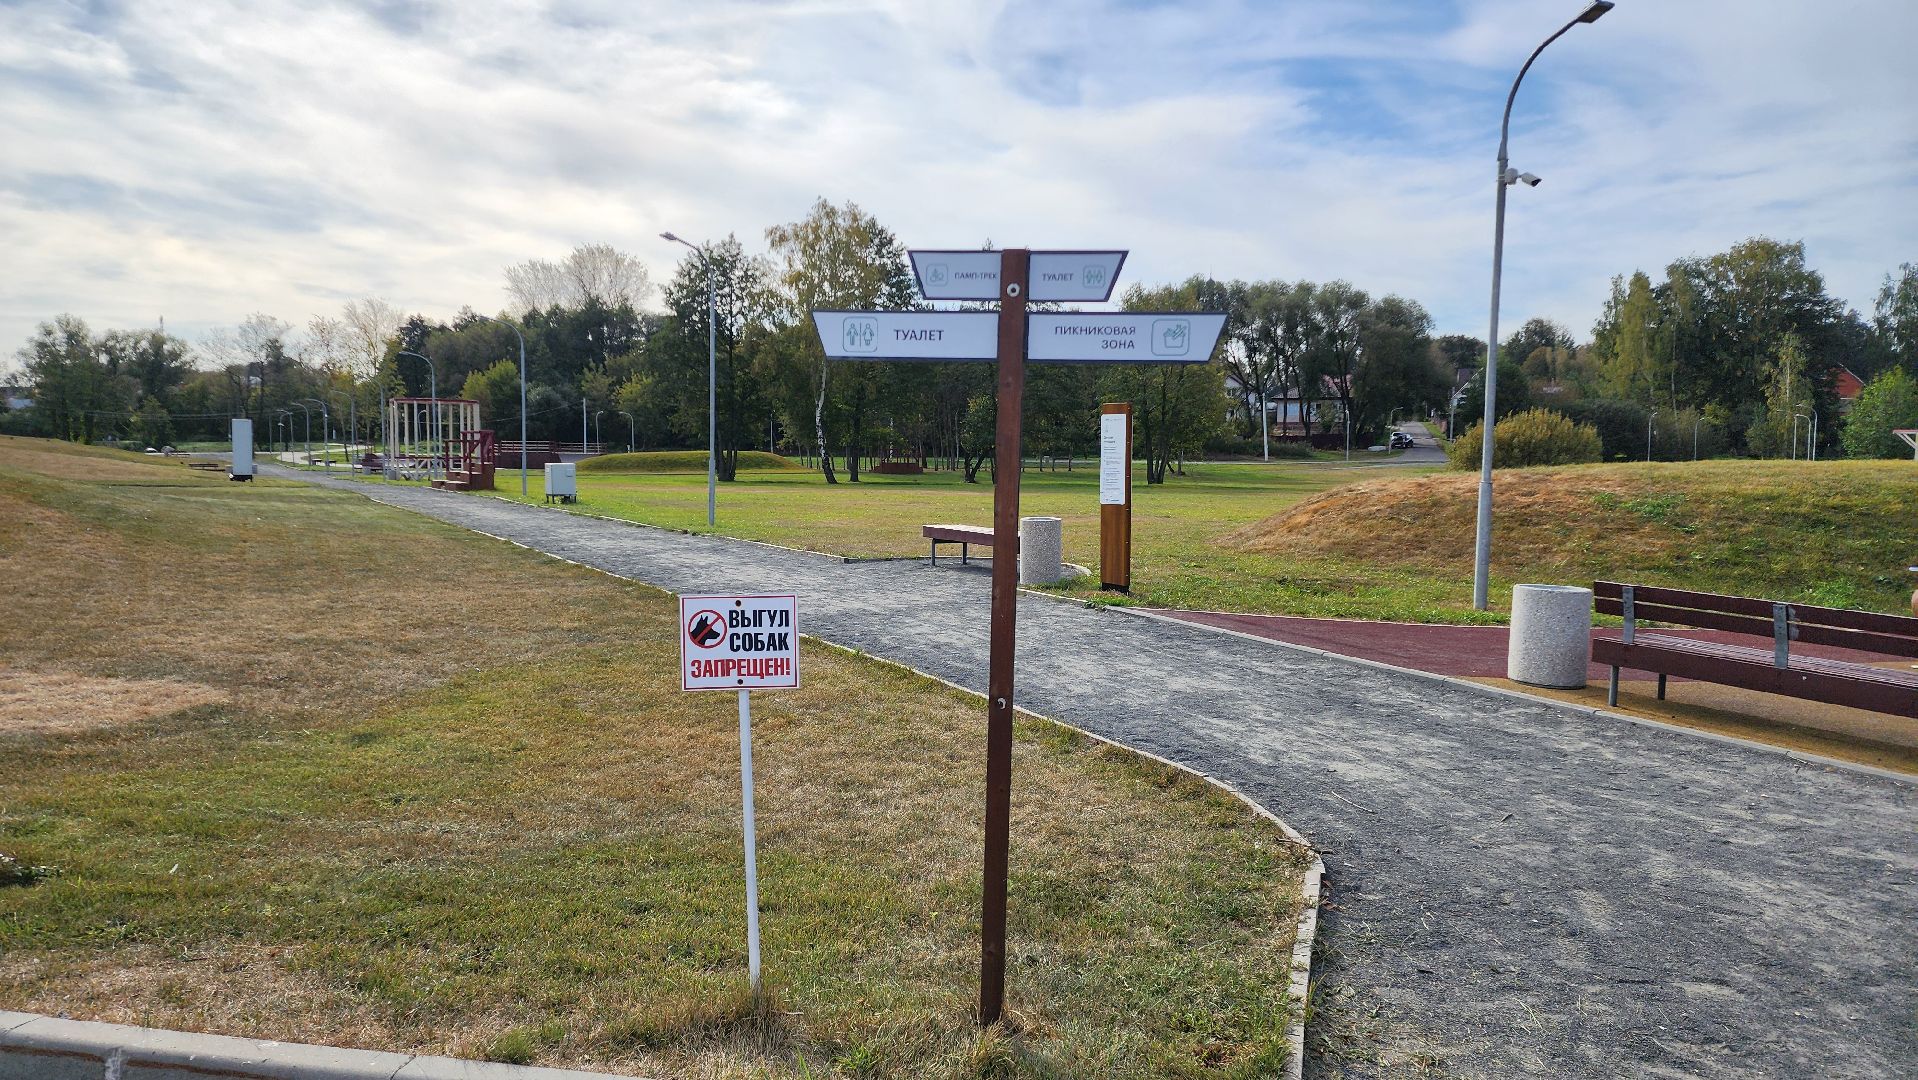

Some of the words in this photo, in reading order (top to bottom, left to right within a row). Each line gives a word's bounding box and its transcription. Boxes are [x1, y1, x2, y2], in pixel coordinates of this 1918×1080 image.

[954, 272, 998, 280] ПАМП-ТРЕК
[1042, 273, 1075, 281] ТУАЛЕТ
[893, 329, 945, 341] ТУАЛЕТ
[1054, 326, 1136, 336] ПИКНИКОВАЯ
[1101, 340, 1135, 349] ЗОНА
[728, 609, 790, 628] ВЫГУЛ
[729, 632, 790, 652] СОБАК
[690, 658, 791, 679] ЗАПРЕЩЕН!
